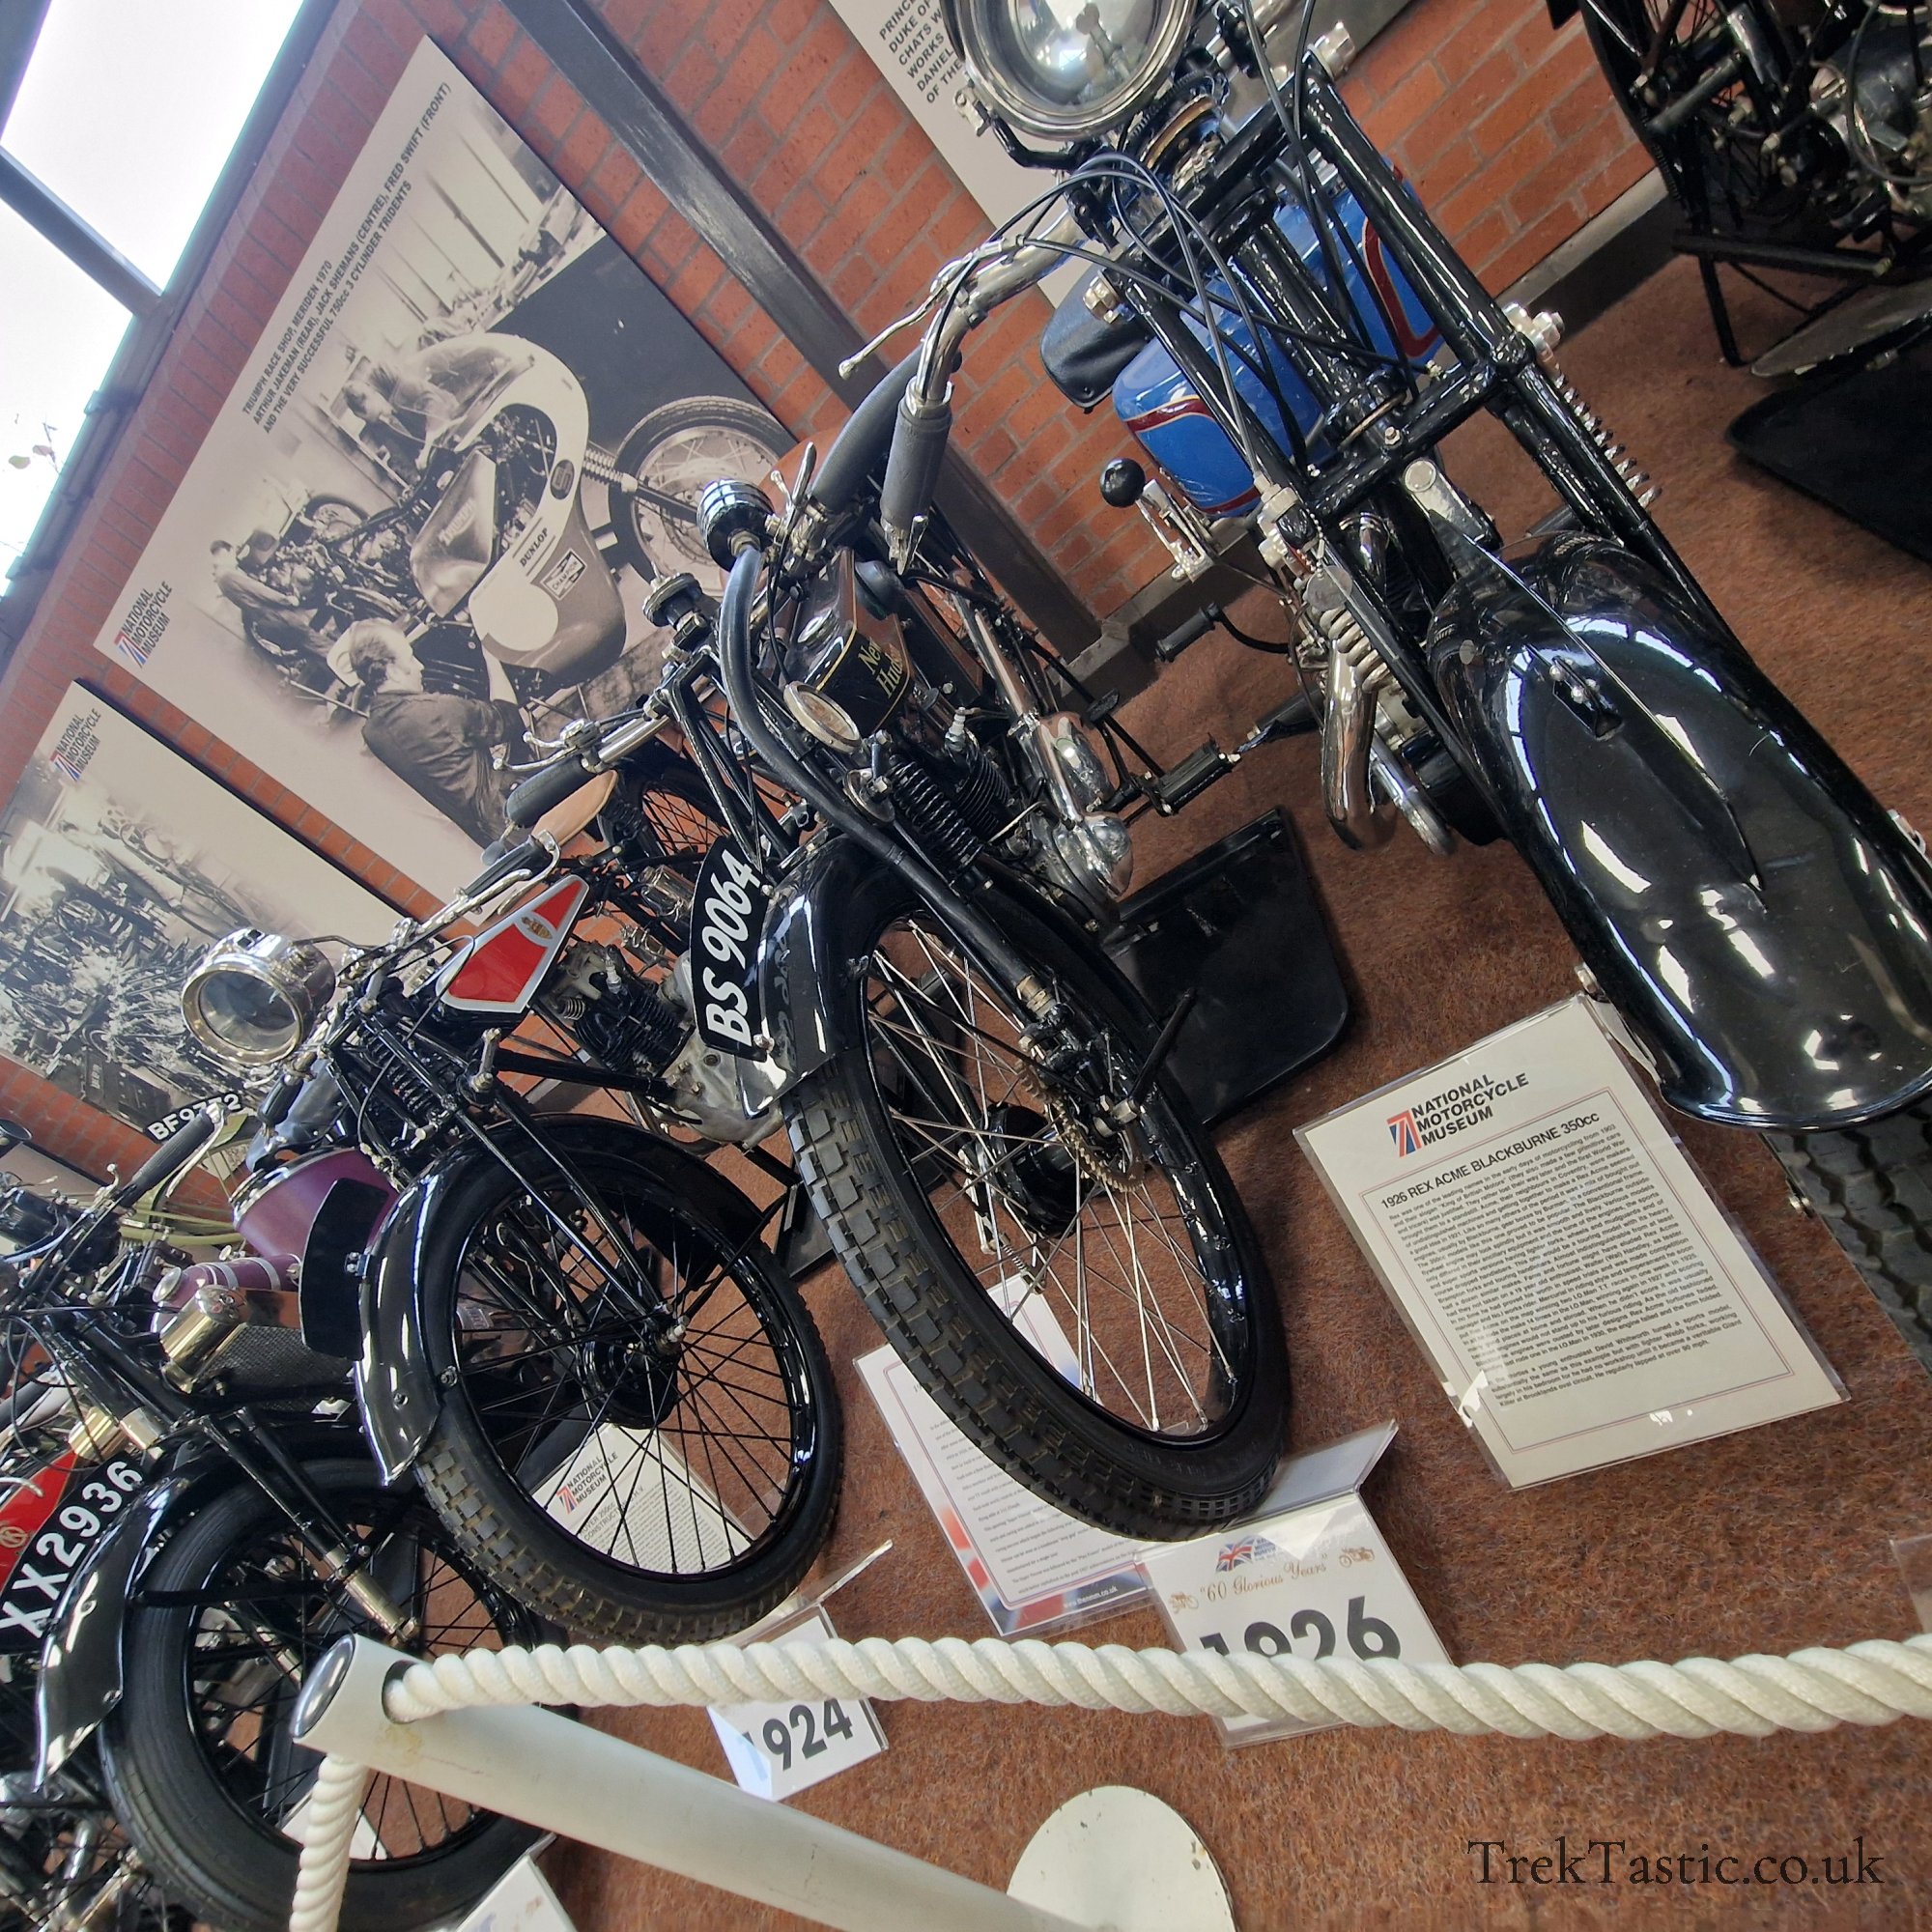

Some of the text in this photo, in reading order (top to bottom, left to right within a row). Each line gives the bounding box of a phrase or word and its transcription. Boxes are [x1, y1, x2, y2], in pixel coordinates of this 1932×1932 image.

[889, 15, 918, 53] DUKE
[898, 23, 931, 66] CHATS
[907, 33, 944, 79] WORKS
[917, 47, 954, 92] DANIEL
[926, 58, 963, 104] OF THE
[252, 388, 276, 424] ARTHUR
[271, 348, 299, 389] JAKEMAN
[314, 289, 332, 315] JACK
[328, 242, 359, 289] SHEMANS
[384, 162, 405, 192] FRED
[400, 128, 424, 163] SWIFT
[419, 82, 452, 130] (FRONT)
[263, 181, 411, 434] AND THE VERY SUCCESSFUL 750cc 3 CYLINDER TRIDENTS
[242, 260, 332, 414] TRIUMPH RACE SHOP, MERIDEN 1970
[520, 527, 549, 567] DUNLOP
[553, 560, 579, 590] CHAMPION
[121, 588, 154, 637] NATIONAL
[131, 581, 172, 645] MOTORCYCLE
[141, 611, 170, 655] MUSEUM
[56, 714, 84, 753] NATIONAL
[66, 708, 100, 762] MOTORCYCLE
[75, 735, 100, 771] MUSEUM
[701, 849, 760, 1046] BS 9064
[1411, 1074, 1495, 1119] NATIONAL
[1416, 1072, 1529, 1132] MOTORCYCLE
[1421, 1105, 1493, 1147] MUSEUM
[1380, 1111, 1600, 1209] 1926 REX ACME BLACKBURNE 350cc
[567, 1456, 602, 1488] NATIONAL
[576, 1474, 607, 1503] MUSEUM
[0, 1461, 143, 1638] XX2936
[1234, 1575, 1284, 1596] Glorious
